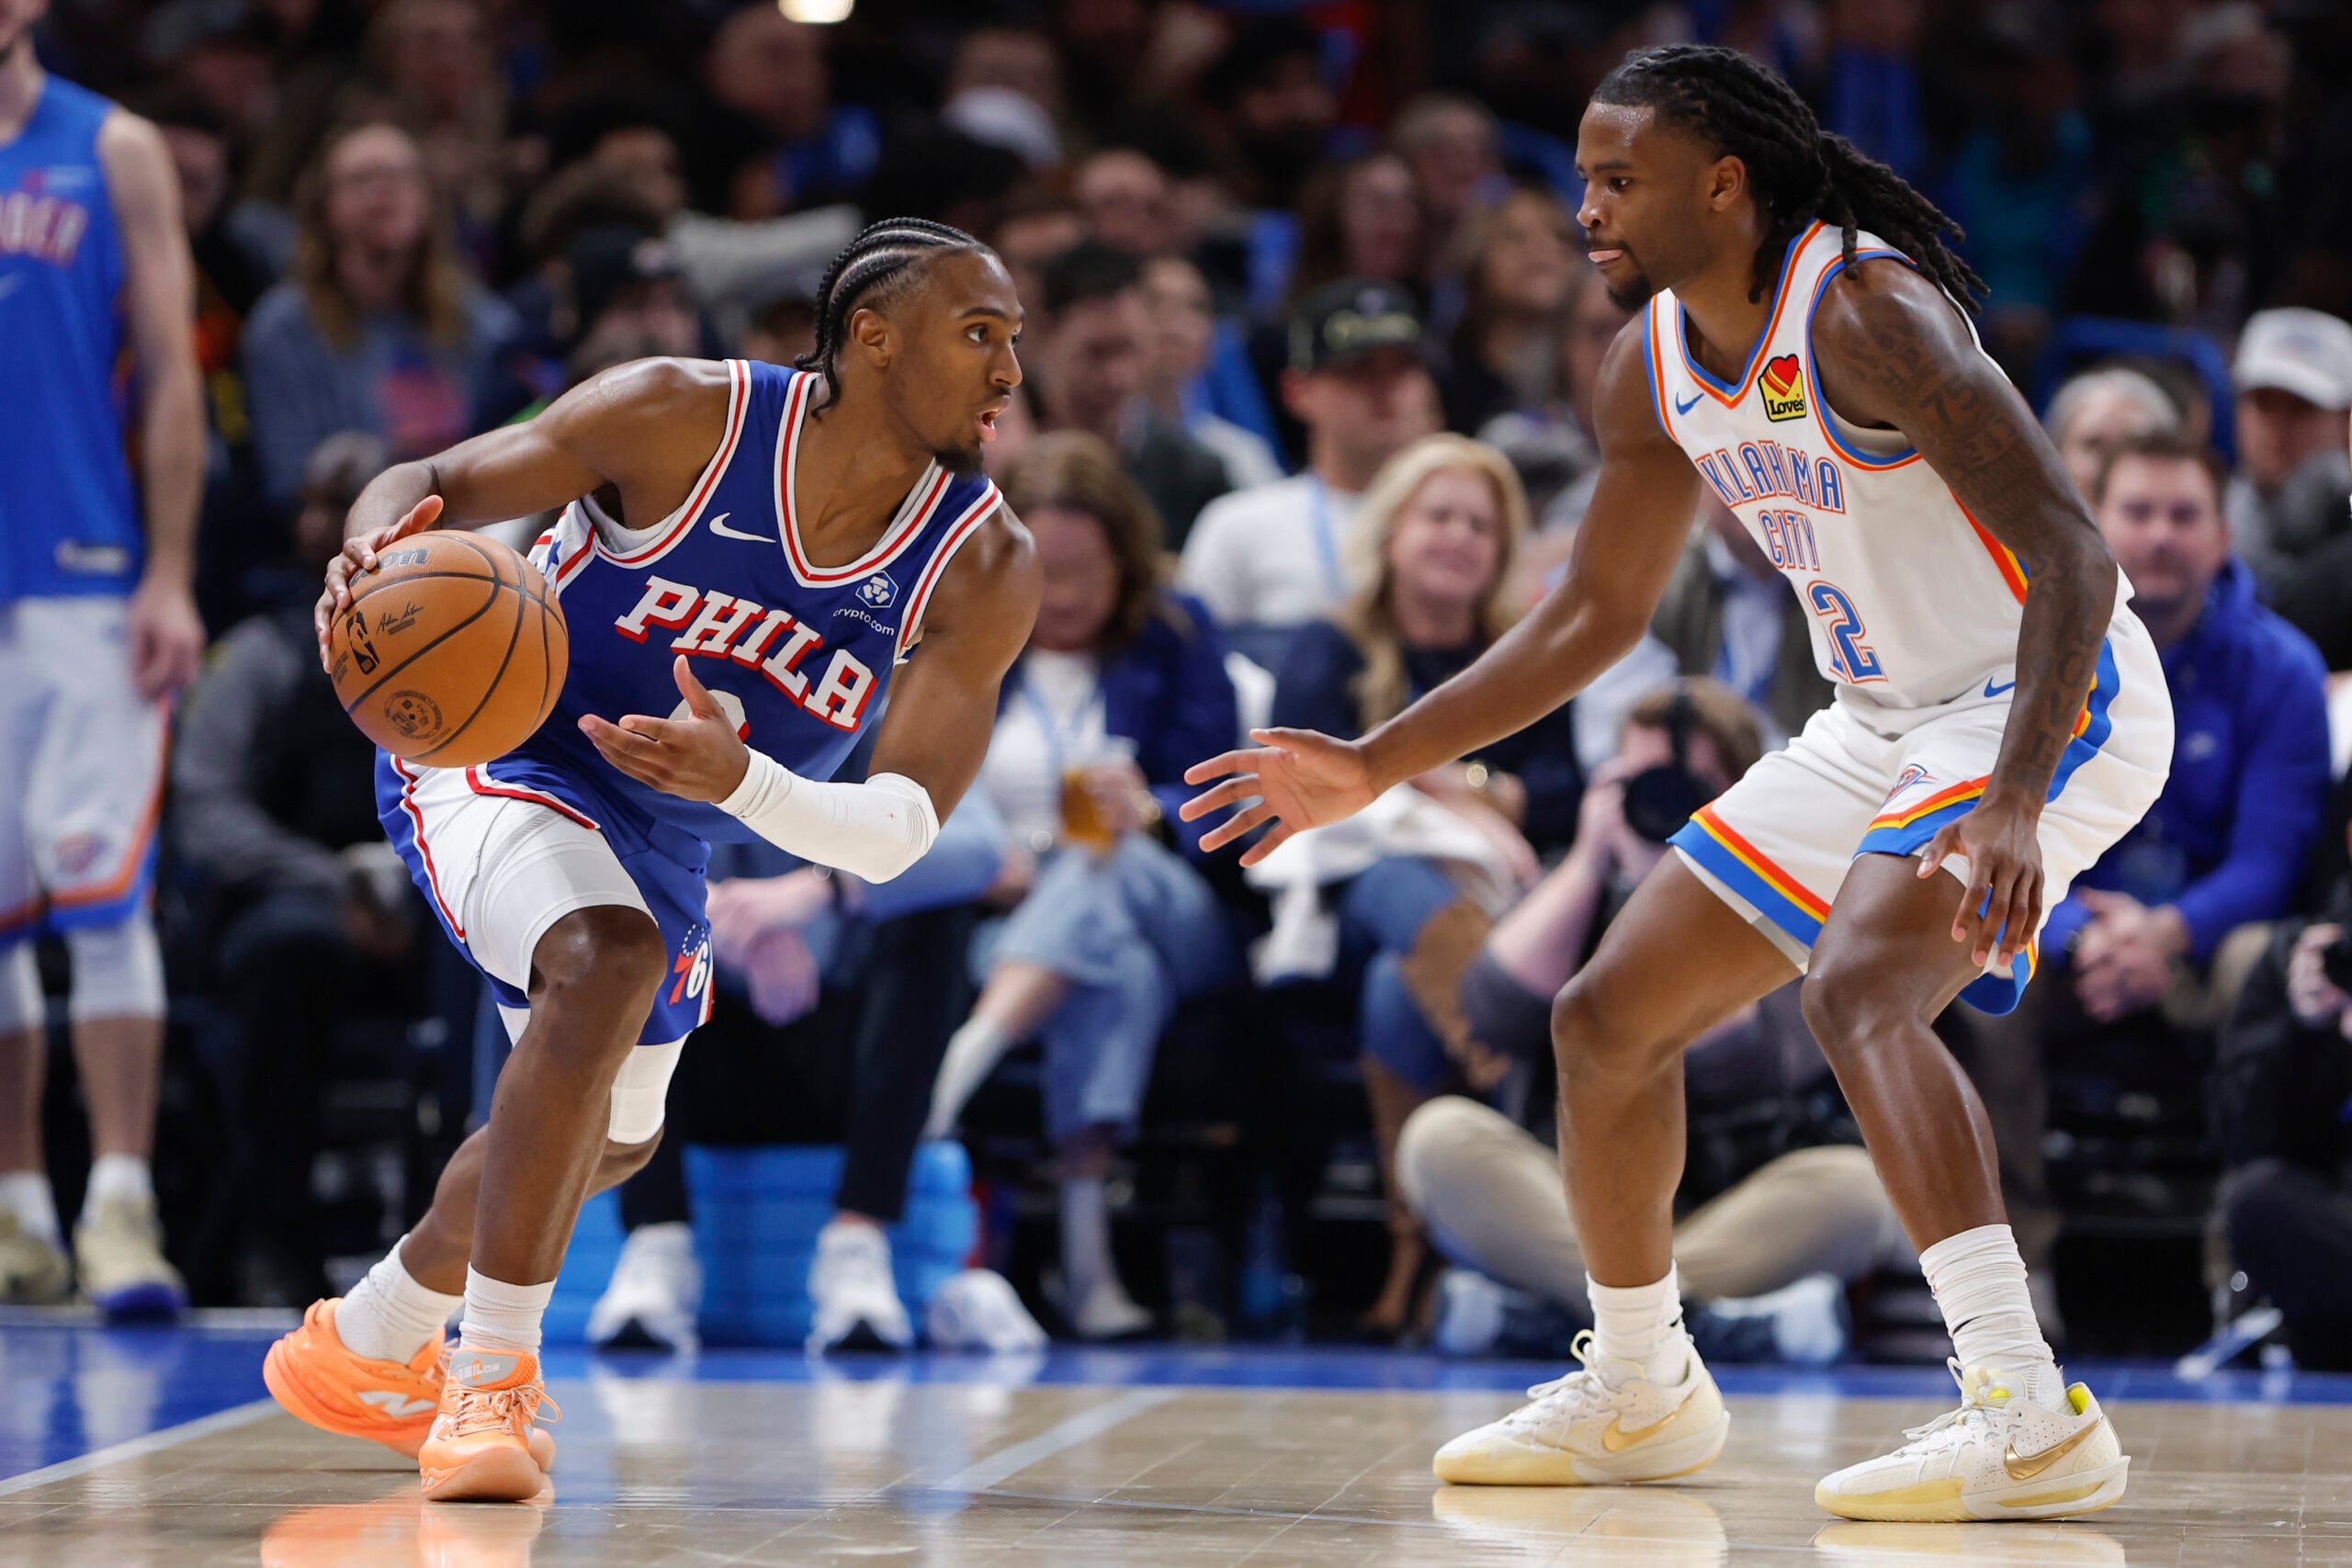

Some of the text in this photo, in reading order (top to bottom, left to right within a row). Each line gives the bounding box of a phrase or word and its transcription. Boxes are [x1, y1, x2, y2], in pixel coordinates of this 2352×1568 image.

[1695, 440, 1846, 514] KLAHMA
[1758, 510, 1820, 572] CITY
[615, 575, 877, 733] PHILA
[832, 608, 895, 636] crypto.com
[669, 941, 709, 1006] 76
